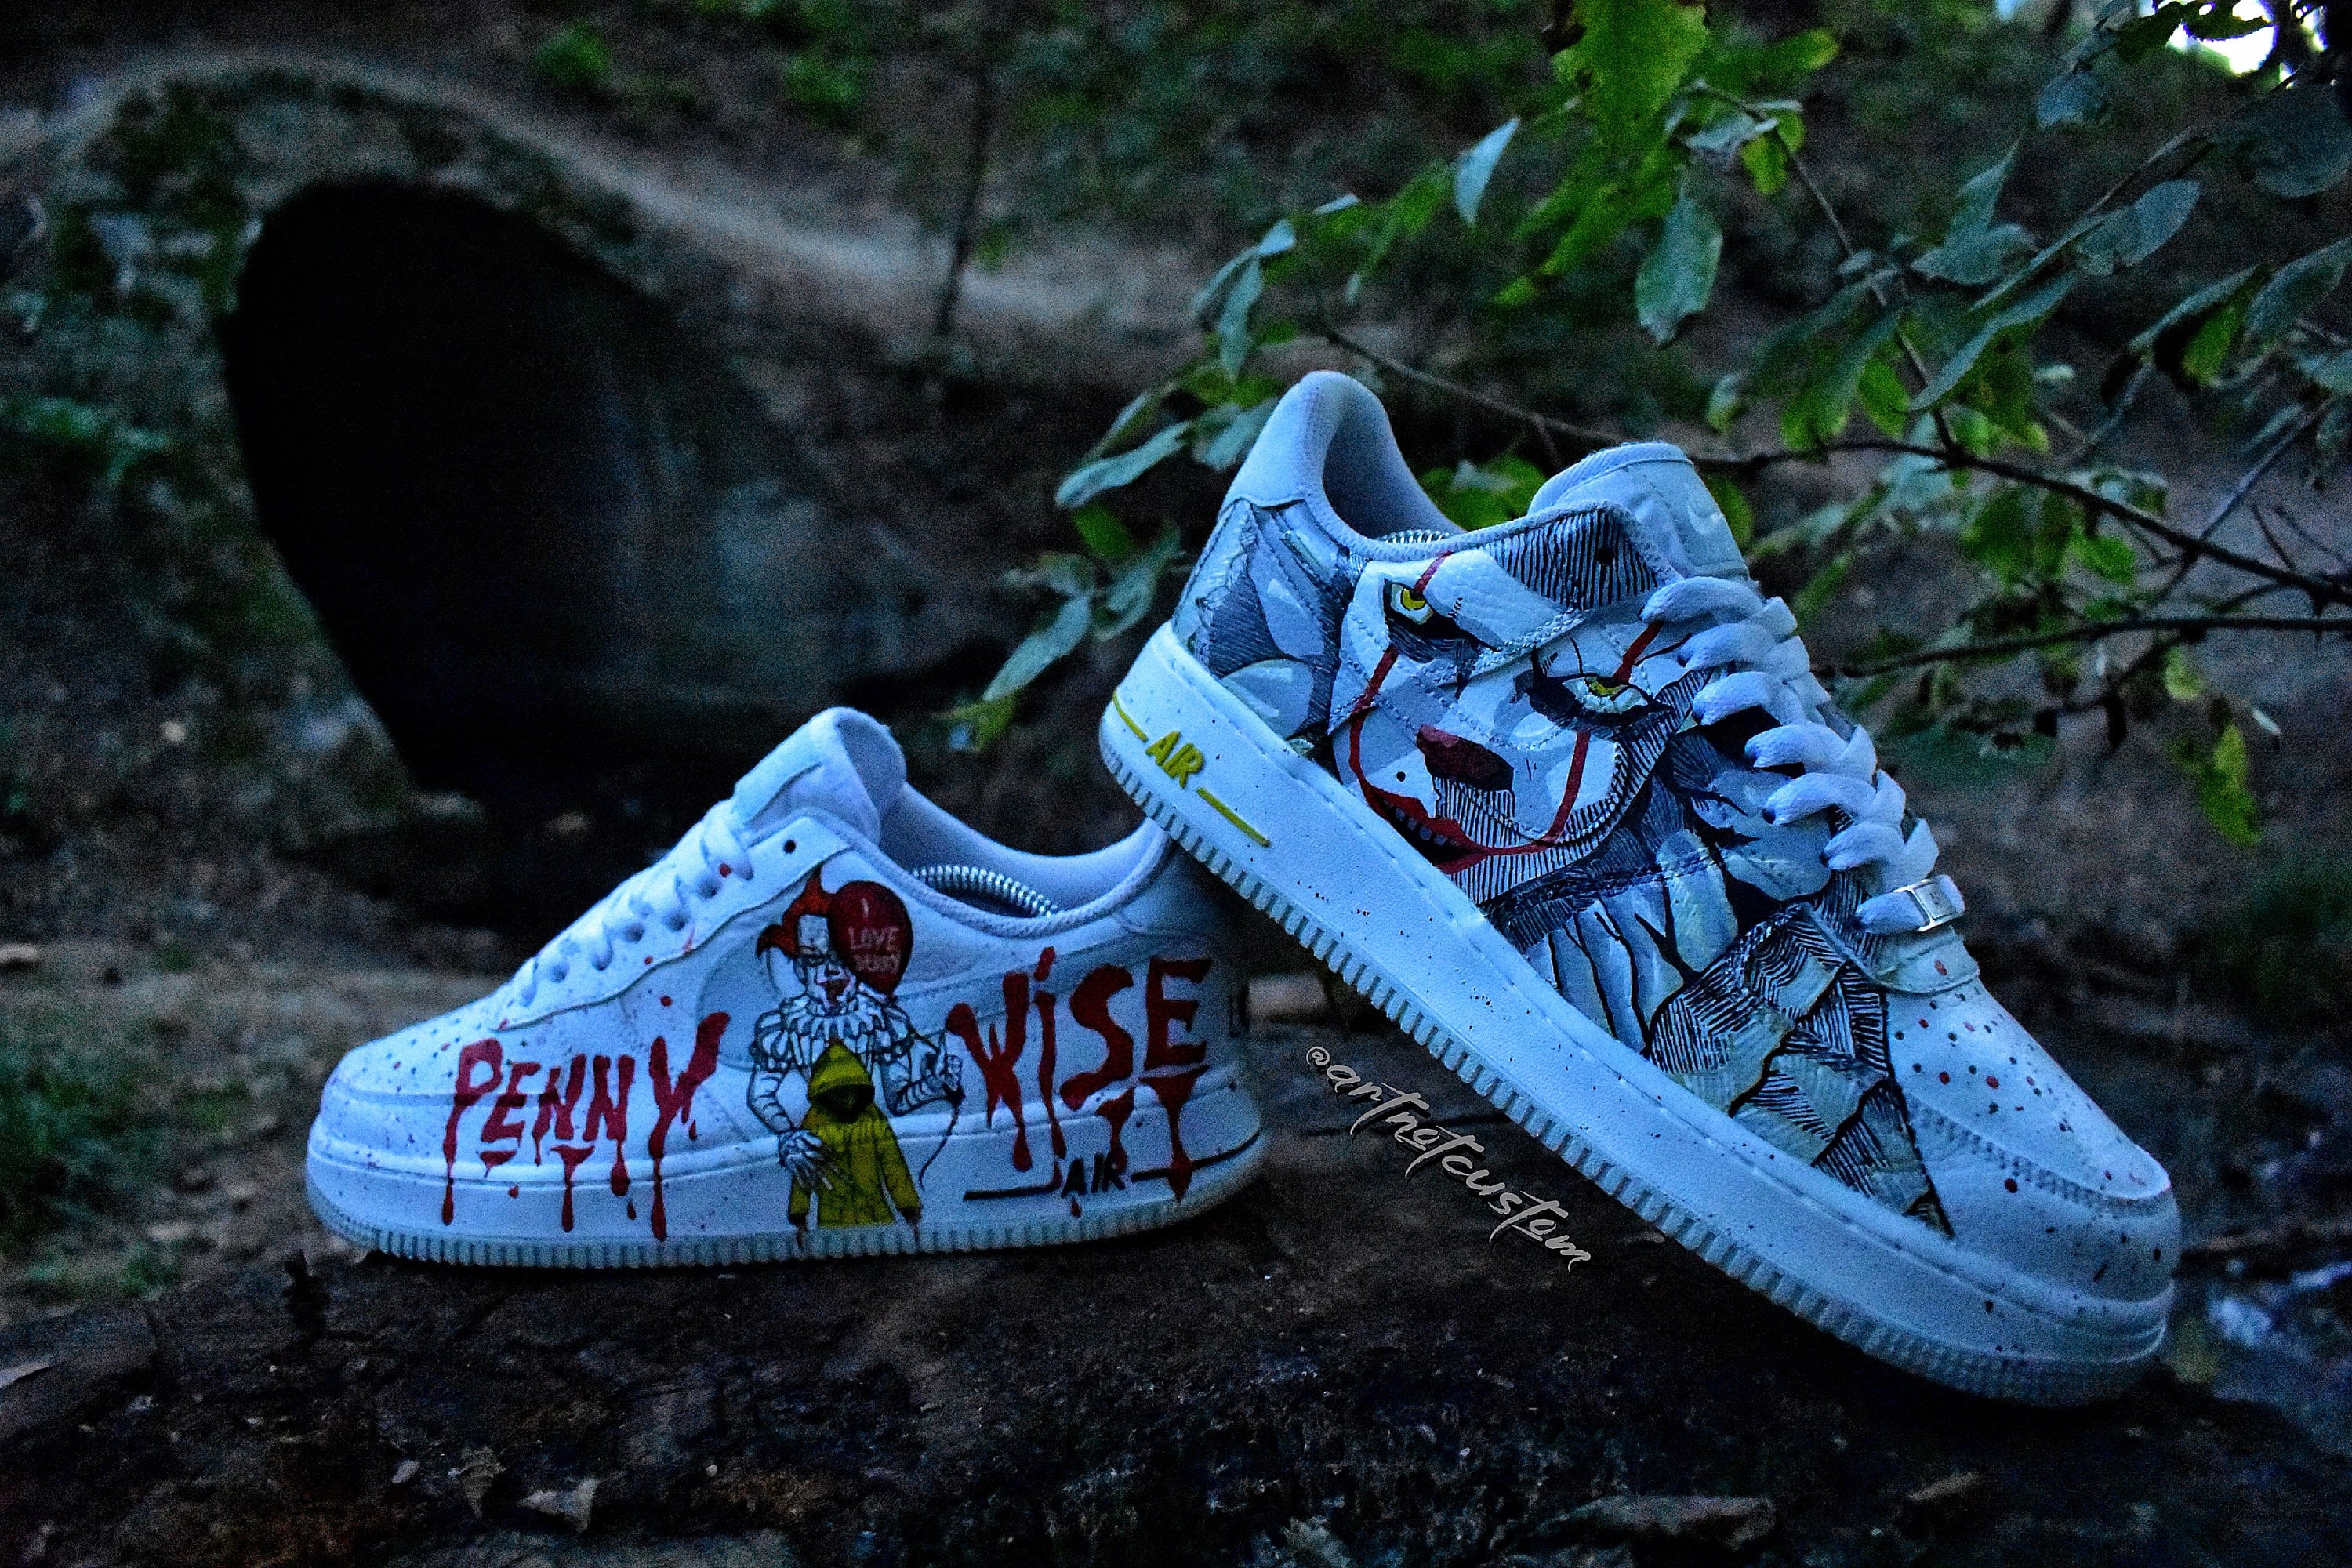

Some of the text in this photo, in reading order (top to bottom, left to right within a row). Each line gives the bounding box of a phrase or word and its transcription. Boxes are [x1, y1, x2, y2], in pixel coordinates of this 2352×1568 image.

[1145, 731, 1204, 789] AIR
[848, 925, 899, 951] LOVE
[442, 1011, 731, 1168] PENNY
[1061, 1152, 1127, 1198] AIR
